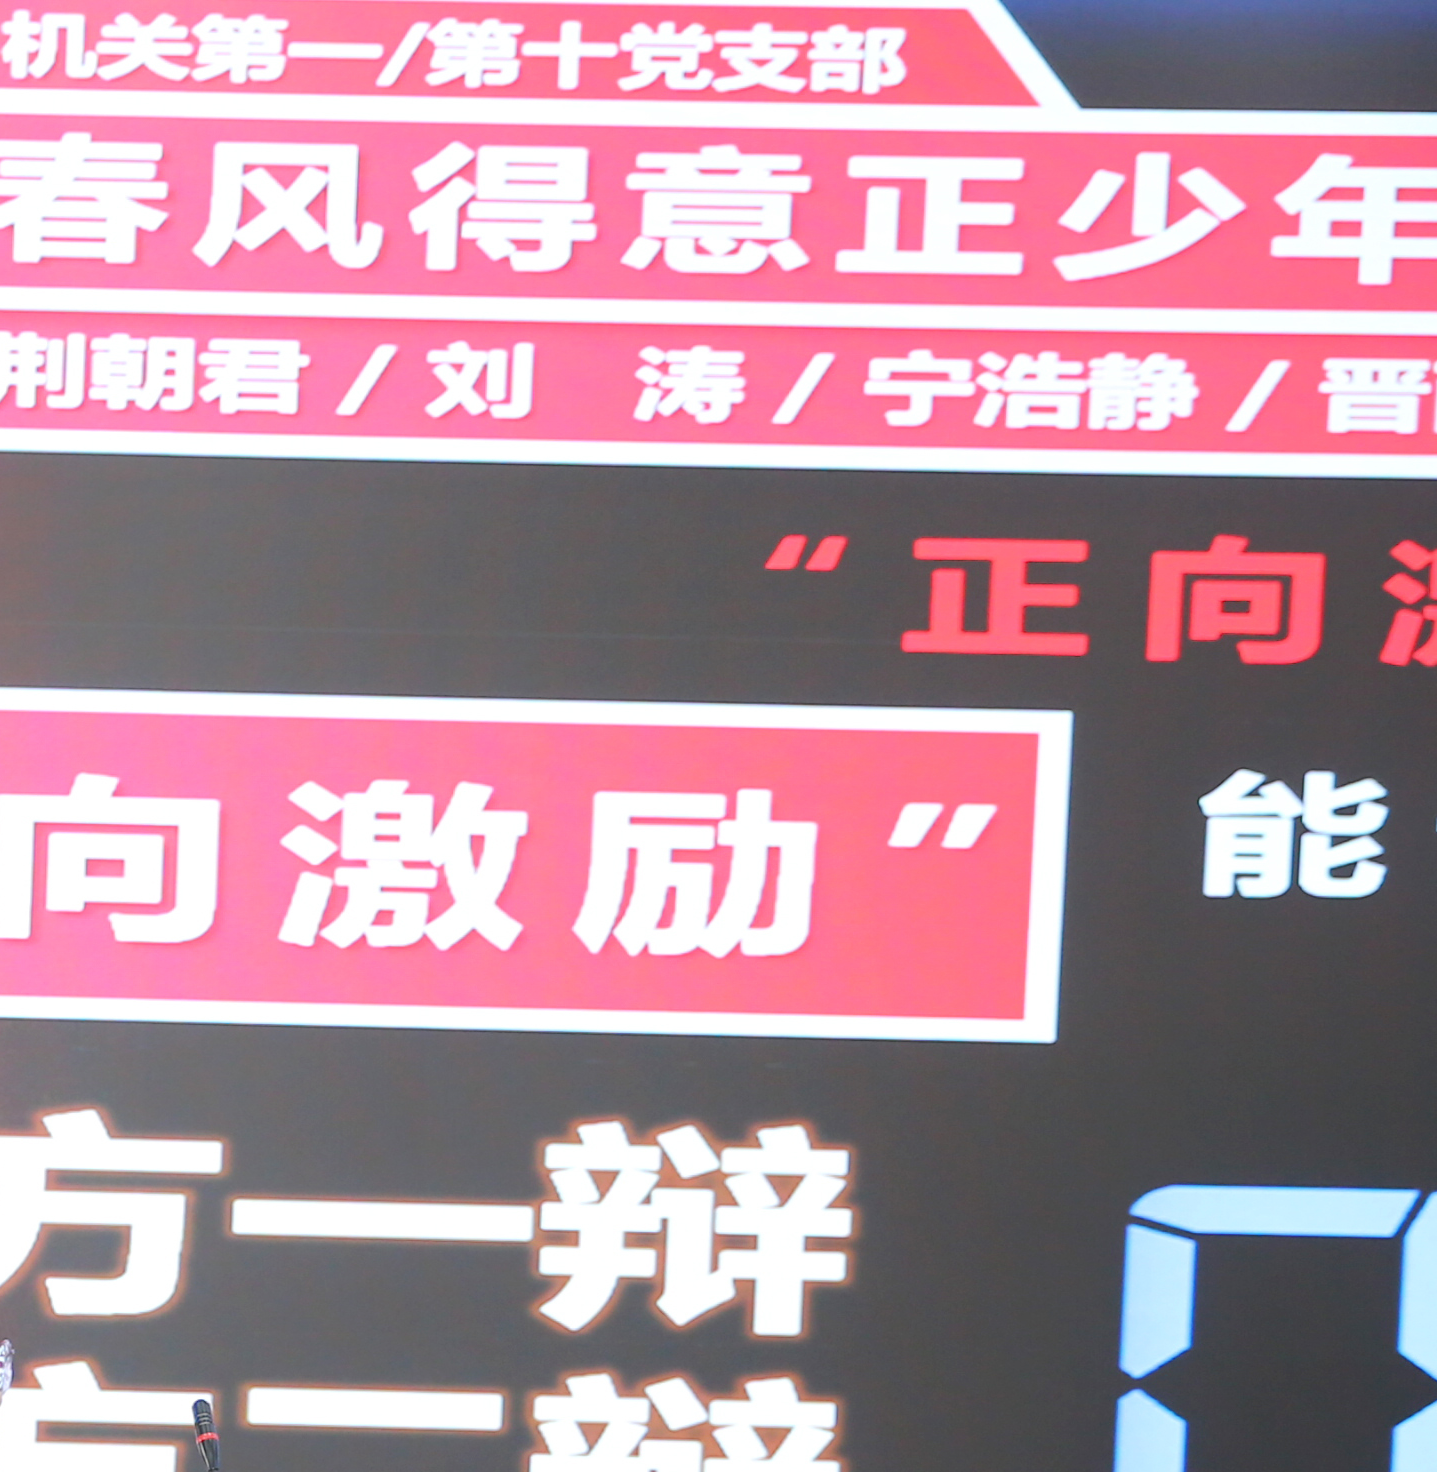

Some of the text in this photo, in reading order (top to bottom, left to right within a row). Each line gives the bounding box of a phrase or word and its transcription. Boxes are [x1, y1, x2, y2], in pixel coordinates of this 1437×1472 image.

[0, 9, 908, 96] 机关第一/第十党支部
[863, 350, 1199, 432] 宁浩静
